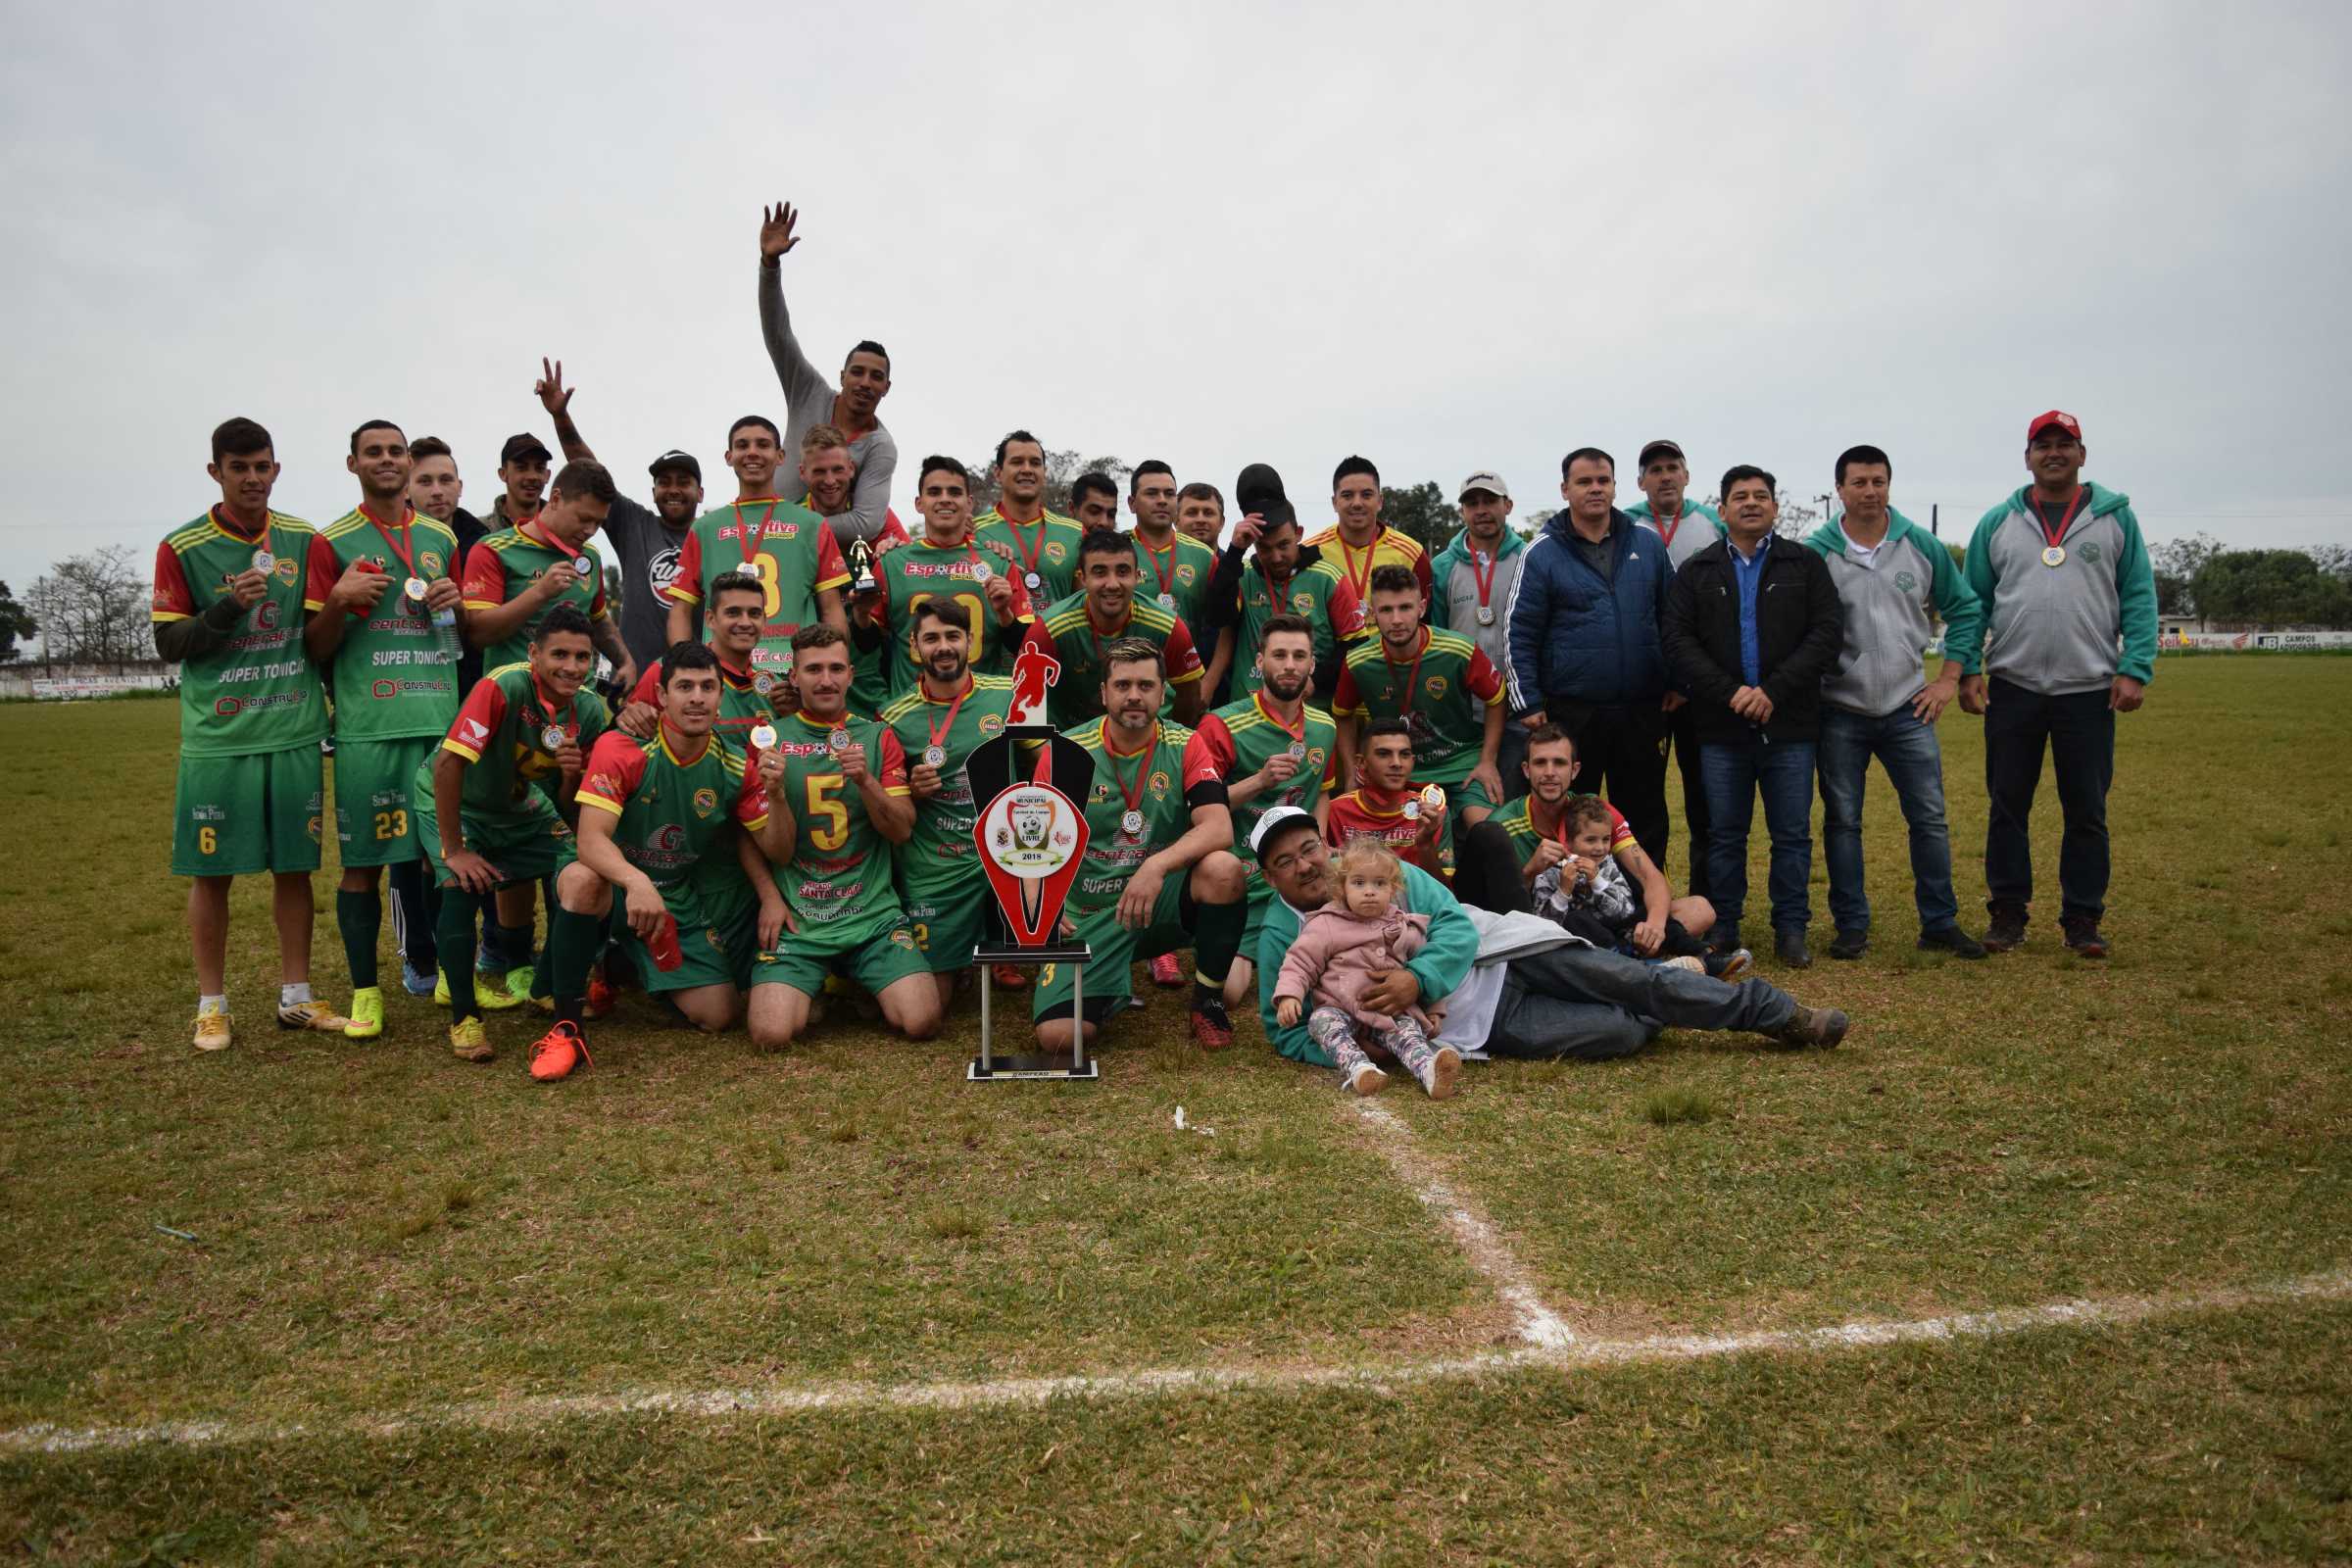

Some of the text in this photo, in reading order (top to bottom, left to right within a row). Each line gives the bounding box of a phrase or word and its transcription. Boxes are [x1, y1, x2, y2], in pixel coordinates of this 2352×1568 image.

[718, 520, 800, 541] Espotiva
[372, 651, 411, 665] SUPER
[220, 665, 260, 682] SUPER
[807, 773, 849, 851] 5
[375, 809, 408, 840] 23
[936, 816, 971, 831] SUPER
[199, 826, 217, 856] 6
[1081, 878, 1123, 894] SUPER
[1042, 963, 1056, 988] 3
